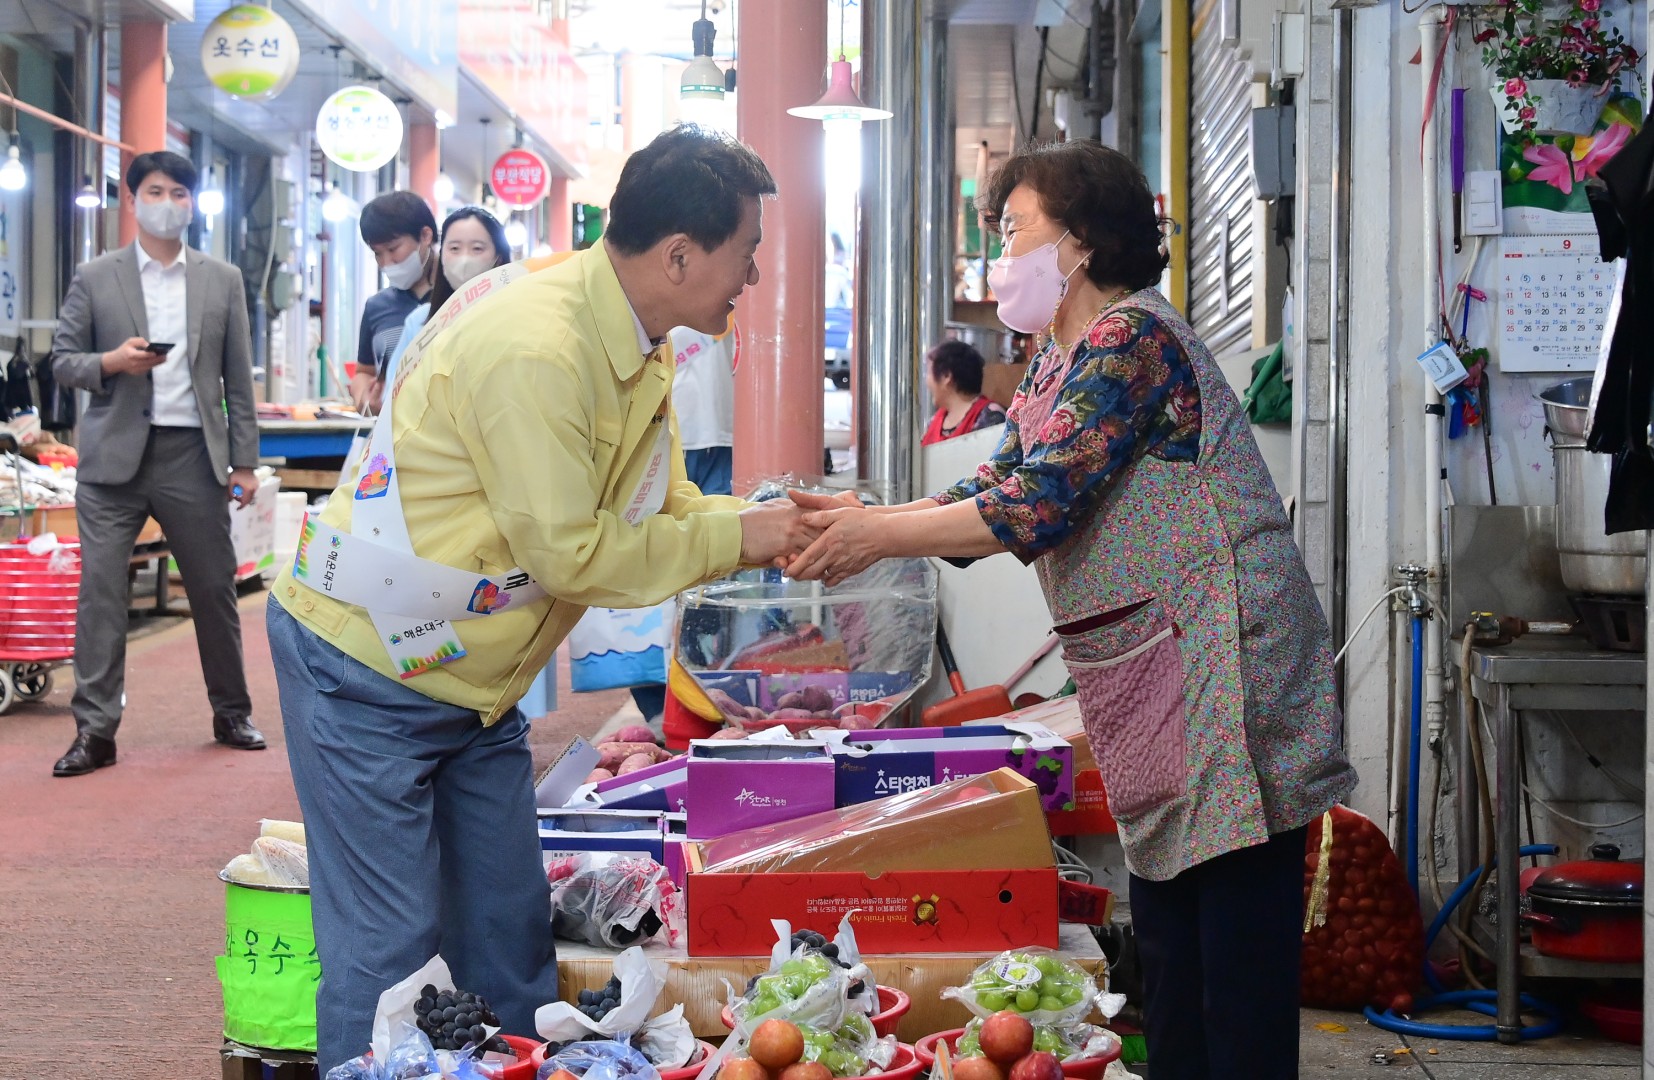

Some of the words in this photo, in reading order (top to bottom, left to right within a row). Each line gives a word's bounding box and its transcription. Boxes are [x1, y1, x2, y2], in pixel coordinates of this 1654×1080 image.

[213, 37, 279, 58] 옷수선
[495, 166, 541, 185] 부산식당
[1563, 240, 1571, 249] 9
[322, 550, 338, 591] 해운대구
[403, 619, 445, 640] 해운대구
[874, 773, 931, 795] 스타영천
[839, 914, 862, 923] Ape
[863, 914, 885, 923] Fruits
[886, 914, 907, 923] Fresh
